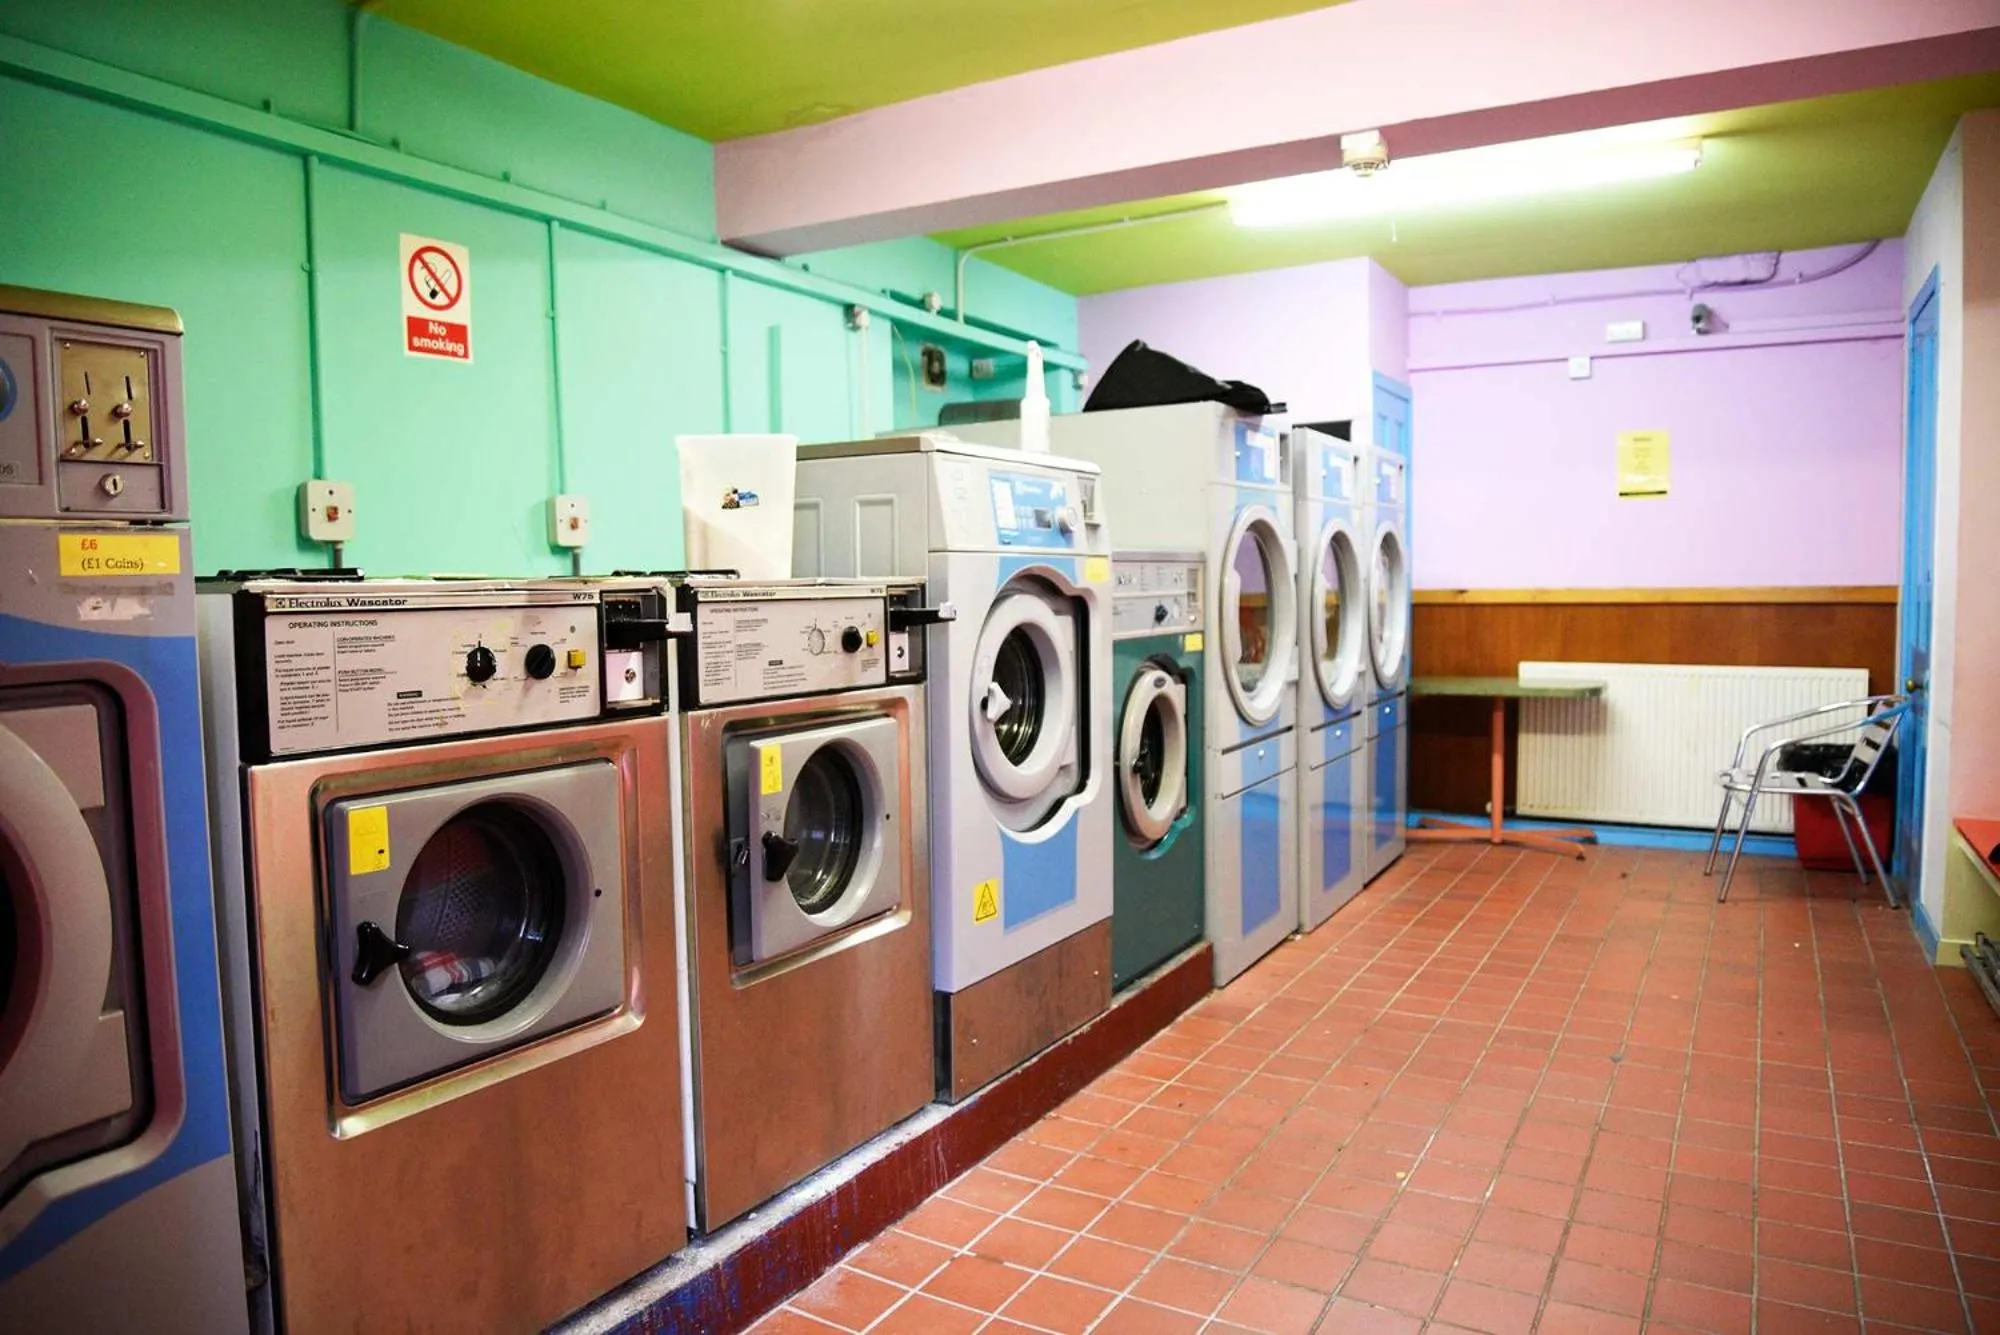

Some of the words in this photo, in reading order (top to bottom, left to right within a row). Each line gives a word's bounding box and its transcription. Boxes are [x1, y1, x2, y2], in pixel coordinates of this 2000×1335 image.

[428, 321, 447, 336] No
[412, 336, 465, 356] smoking
[80, 538, 98, 550] £6
[81, 558, 101, 570] (£1
[105, 557, 144, 570] Coins)
[288, 597, 343, 608] Electrolux
[346, 598, 407, 607] Wascator
[288, 621, 328, 629] OPERATING
[330, 619, 378, 627] INSTRUCTIONS
